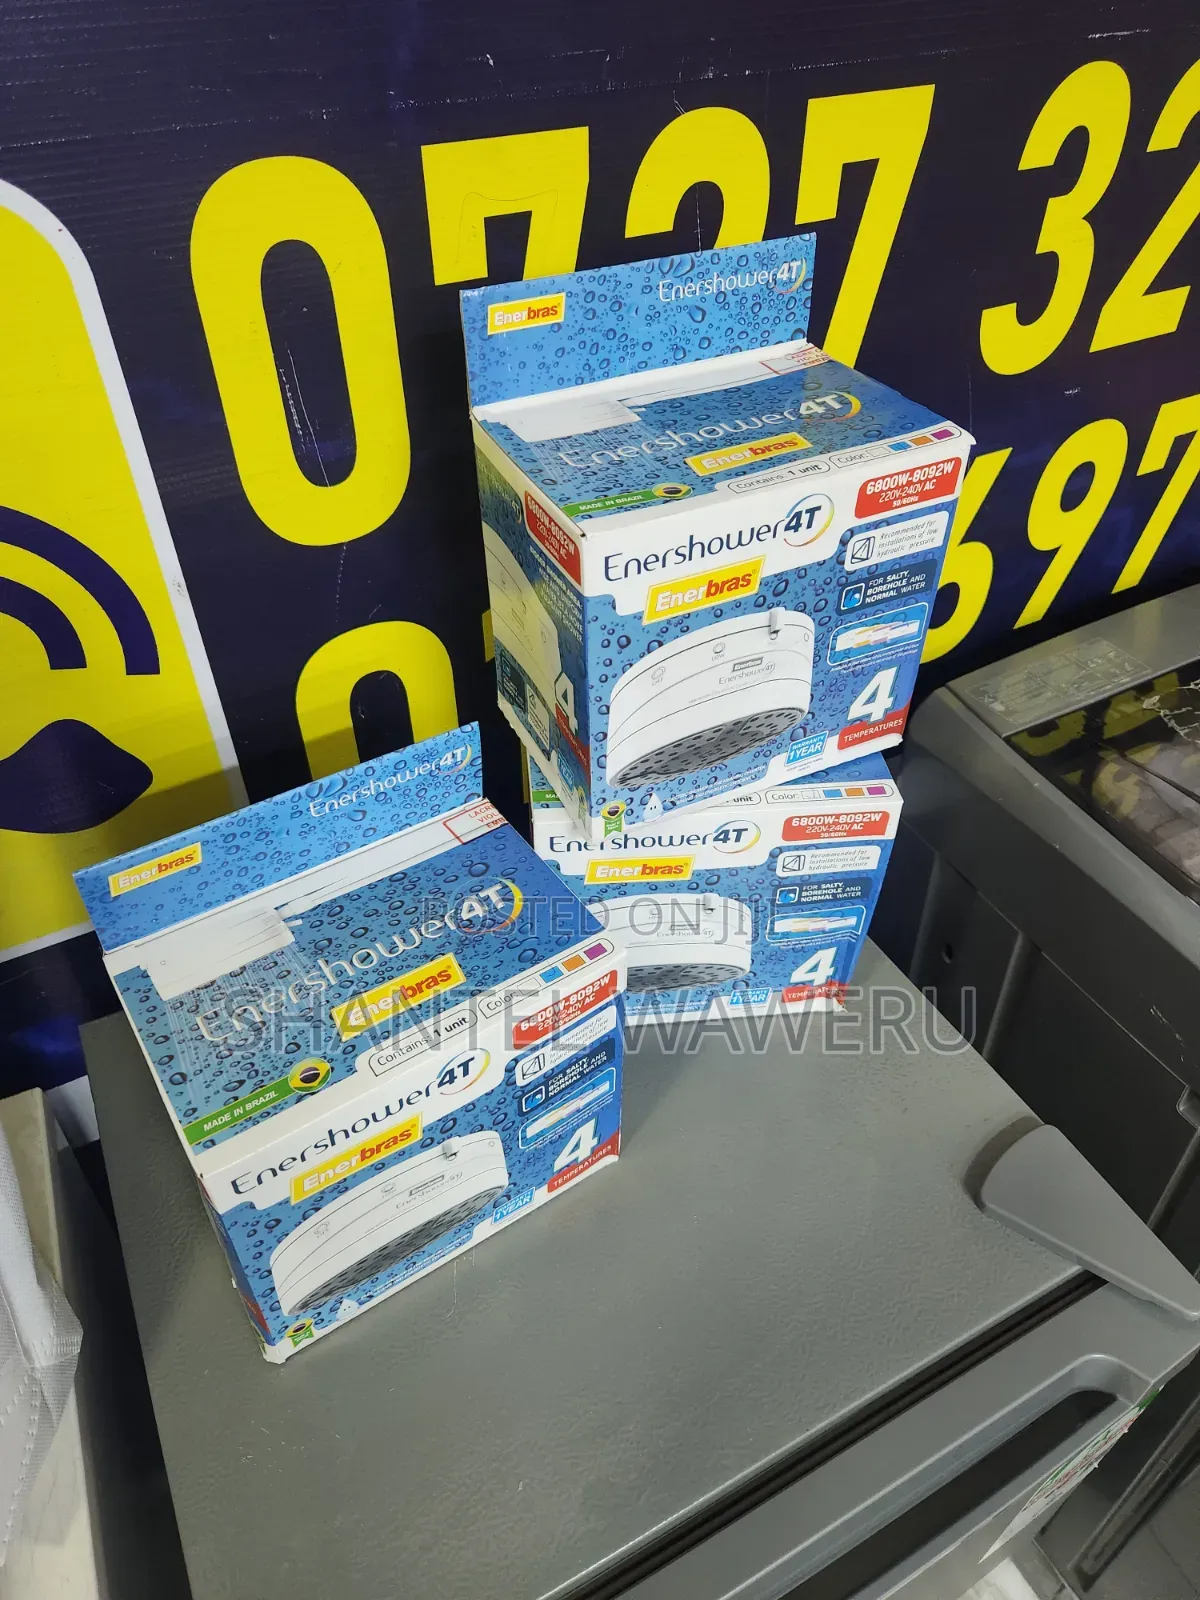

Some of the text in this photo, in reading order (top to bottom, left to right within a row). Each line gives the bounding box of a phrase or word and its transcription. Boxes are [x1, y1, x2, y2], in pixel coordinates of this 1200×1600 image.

[493, 302, 561, 326] Enerbras
[700, 438, 799, 470] Enerbras
[799, 464, 824, 477] unit
[866, 460, 956, 495] 6800W-8092W
[924, 479, 937, 491] AC
[578, 502, 604, 512] MADE
[615, 494, 643, 505] BRAZIL
[604, 505, 822, 582] Enershower4T
[868, 576, 884, 588] FOR
[909, 573, 926, 584] AND
[655, 572, 754, 614] Enerbras
[864, 581, 926, 605] NORMAL WATER
[848, 666, 898, 723] 4
[843, 718, 904, 742] TEMPERATURES
[795, 743, 823, 759] YEAR
[308, 746, 471, 820] Enershower4T
[791, 812, 883, 827] 6800W-8092W
[851, 822, 864, 831] AC
[117, 853, 195, 888] Enerbras
[595, 863, 685, 878] Enerbras
[800, 891, 862, 903] NORMAL WATER
[790, 947, 837, 986] 4
[345, 967, 453, 1028] Enerbras
[583, 995, 596, 1006] AC
[377, 1035, 431, 1066] Contains:
[444, 1017, 469, 1033] unit
[590, 1051, 606, 1063] AND
[203, 1091, 279, 1132] MADE IN BRAZIL
[230, 1055, 476, 1196] Enershower4T
[302, 1128, 412, 1192] Enerbras
[553, 1119, 597, 1173] 4
[552, 1145, 612, 1187] TEMPERATURES
